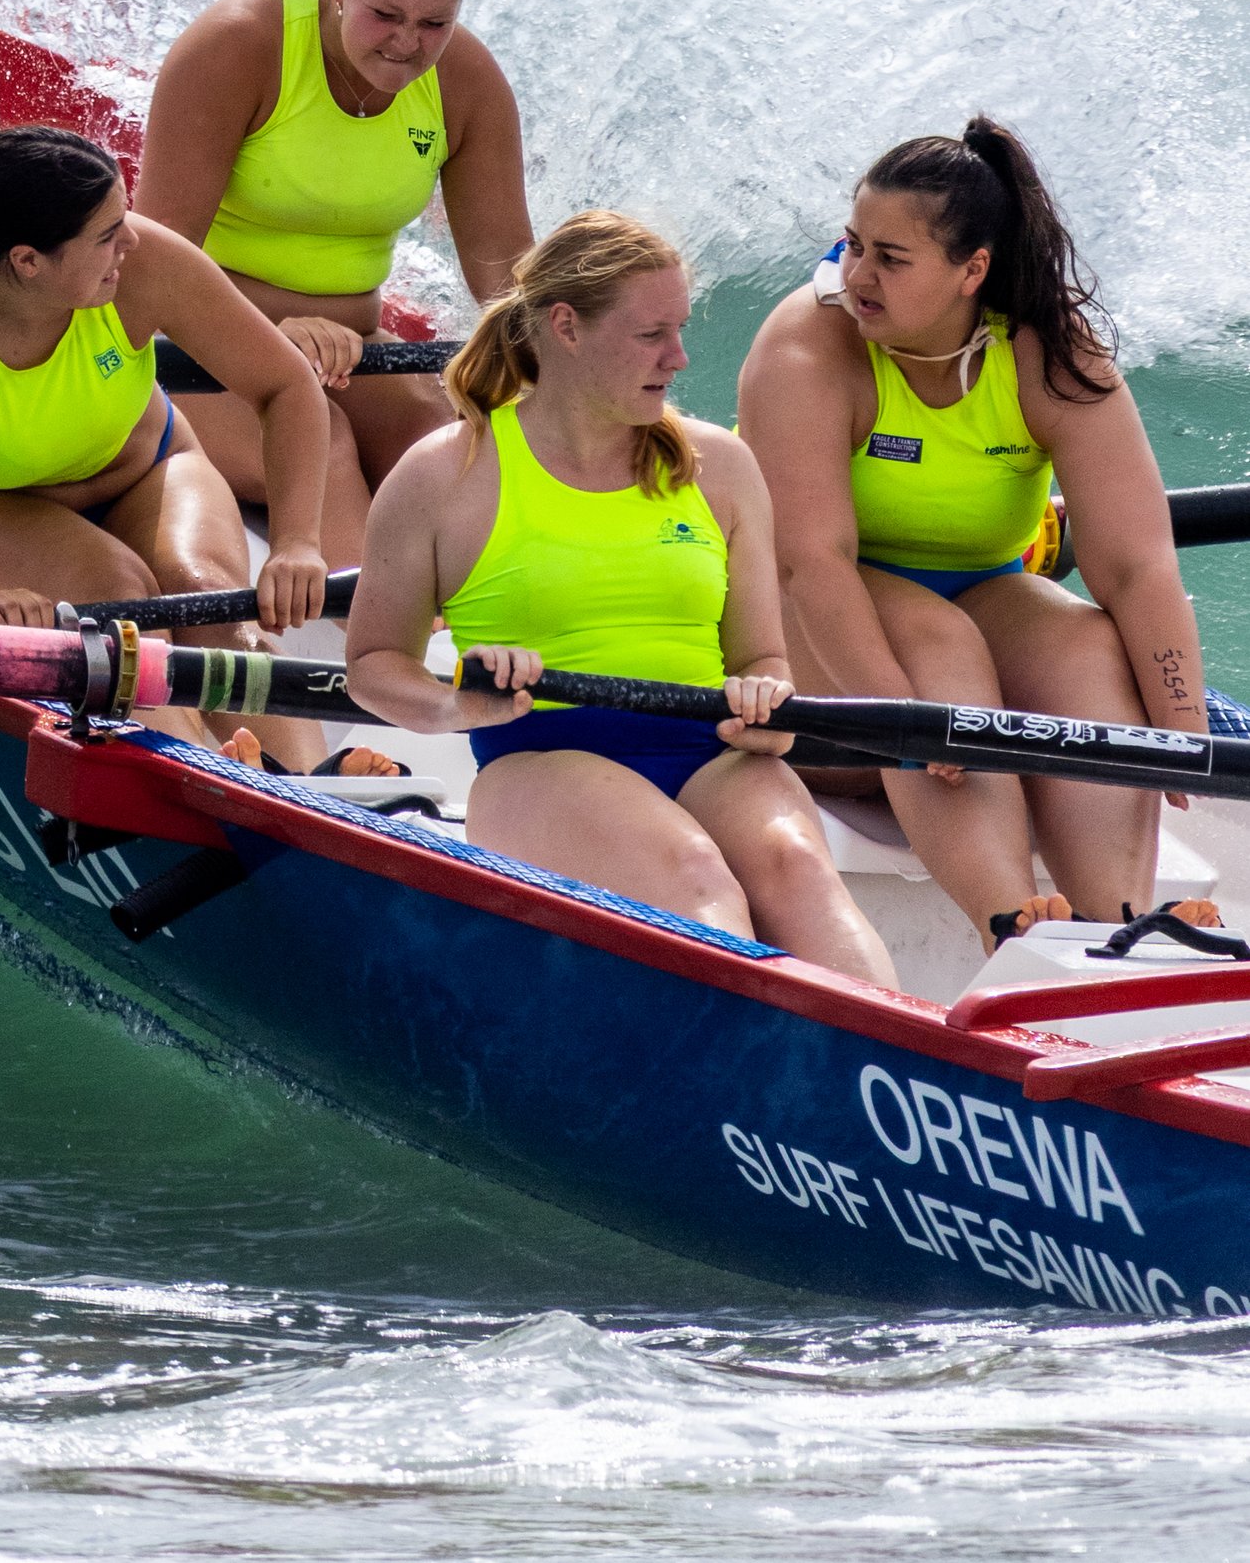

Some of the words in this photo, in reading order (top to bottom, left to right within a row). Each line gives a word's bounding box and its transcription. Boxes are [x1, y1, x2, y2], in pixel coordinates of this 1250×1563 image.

[408, 127, 436, 141] FINZ
[99, 354, 120, 372] T3
[875, 441, 917, 451] CONSTRUCTION
[1153, 649, 1193, 712] 32541
[860, 1064, 1145, 1236] OREWA
[721, 1123, 870, 1229] SURF
[872, 1177, 1193, 1318] LIFESAVING
